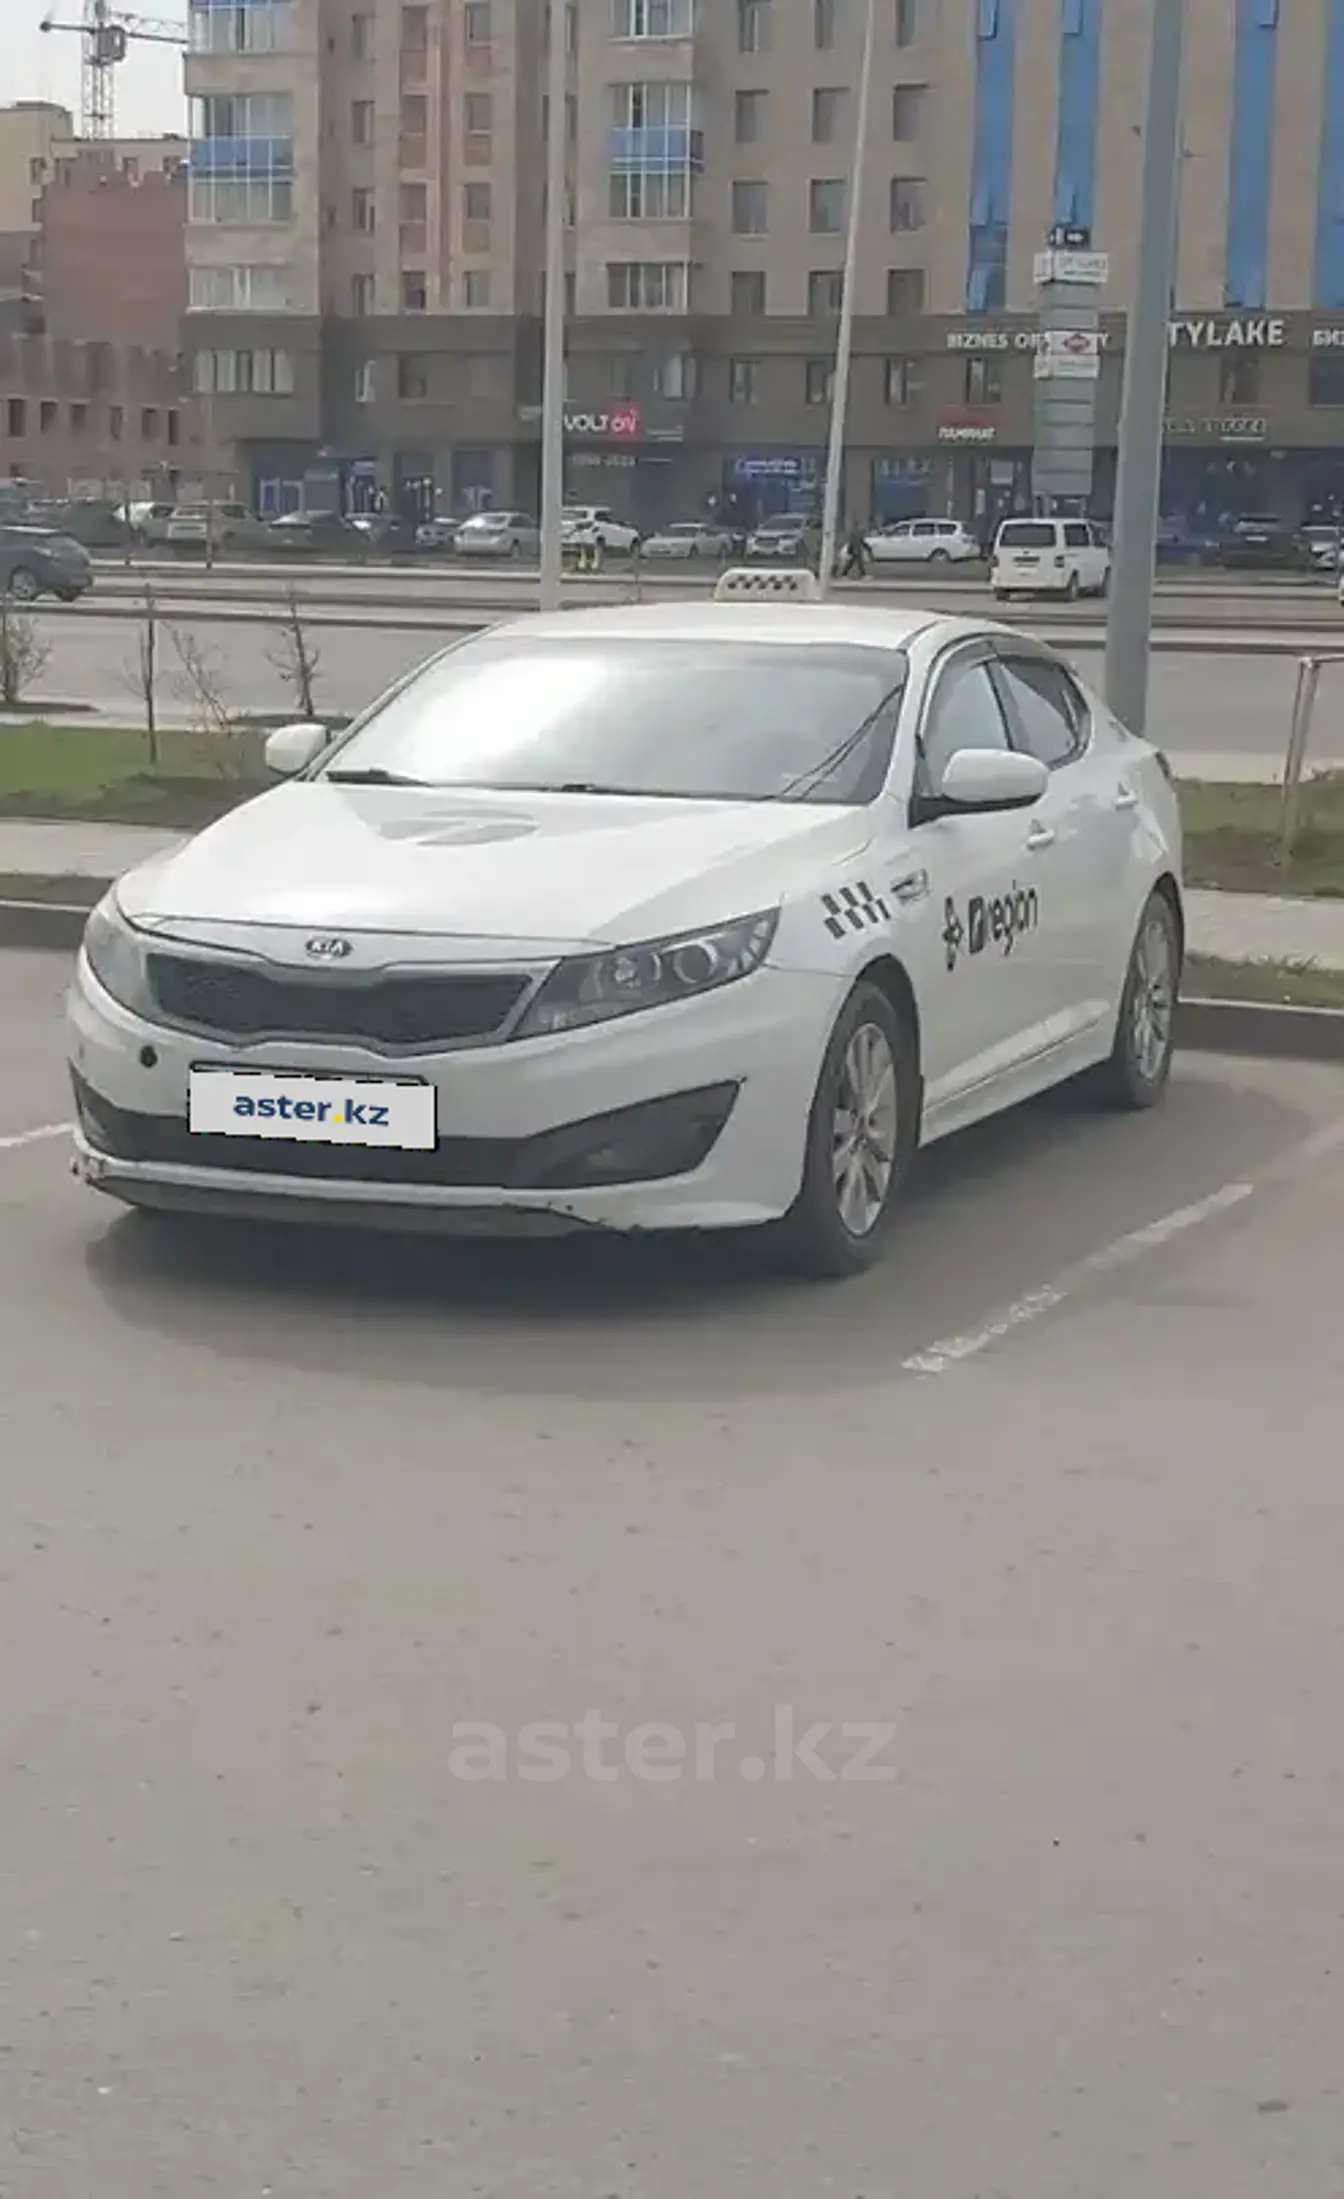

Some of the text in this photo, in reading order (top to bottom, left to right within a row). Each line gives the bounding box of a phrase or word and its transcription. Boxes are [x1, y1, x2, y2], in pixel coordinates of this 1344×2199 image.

[947, 332, 1008, 348] BIZNES
[1168, 319, 1285, 347] TYLAKE
[563, 413, 608, 431] VOLT
[307, 936, 352, 958] KIA
